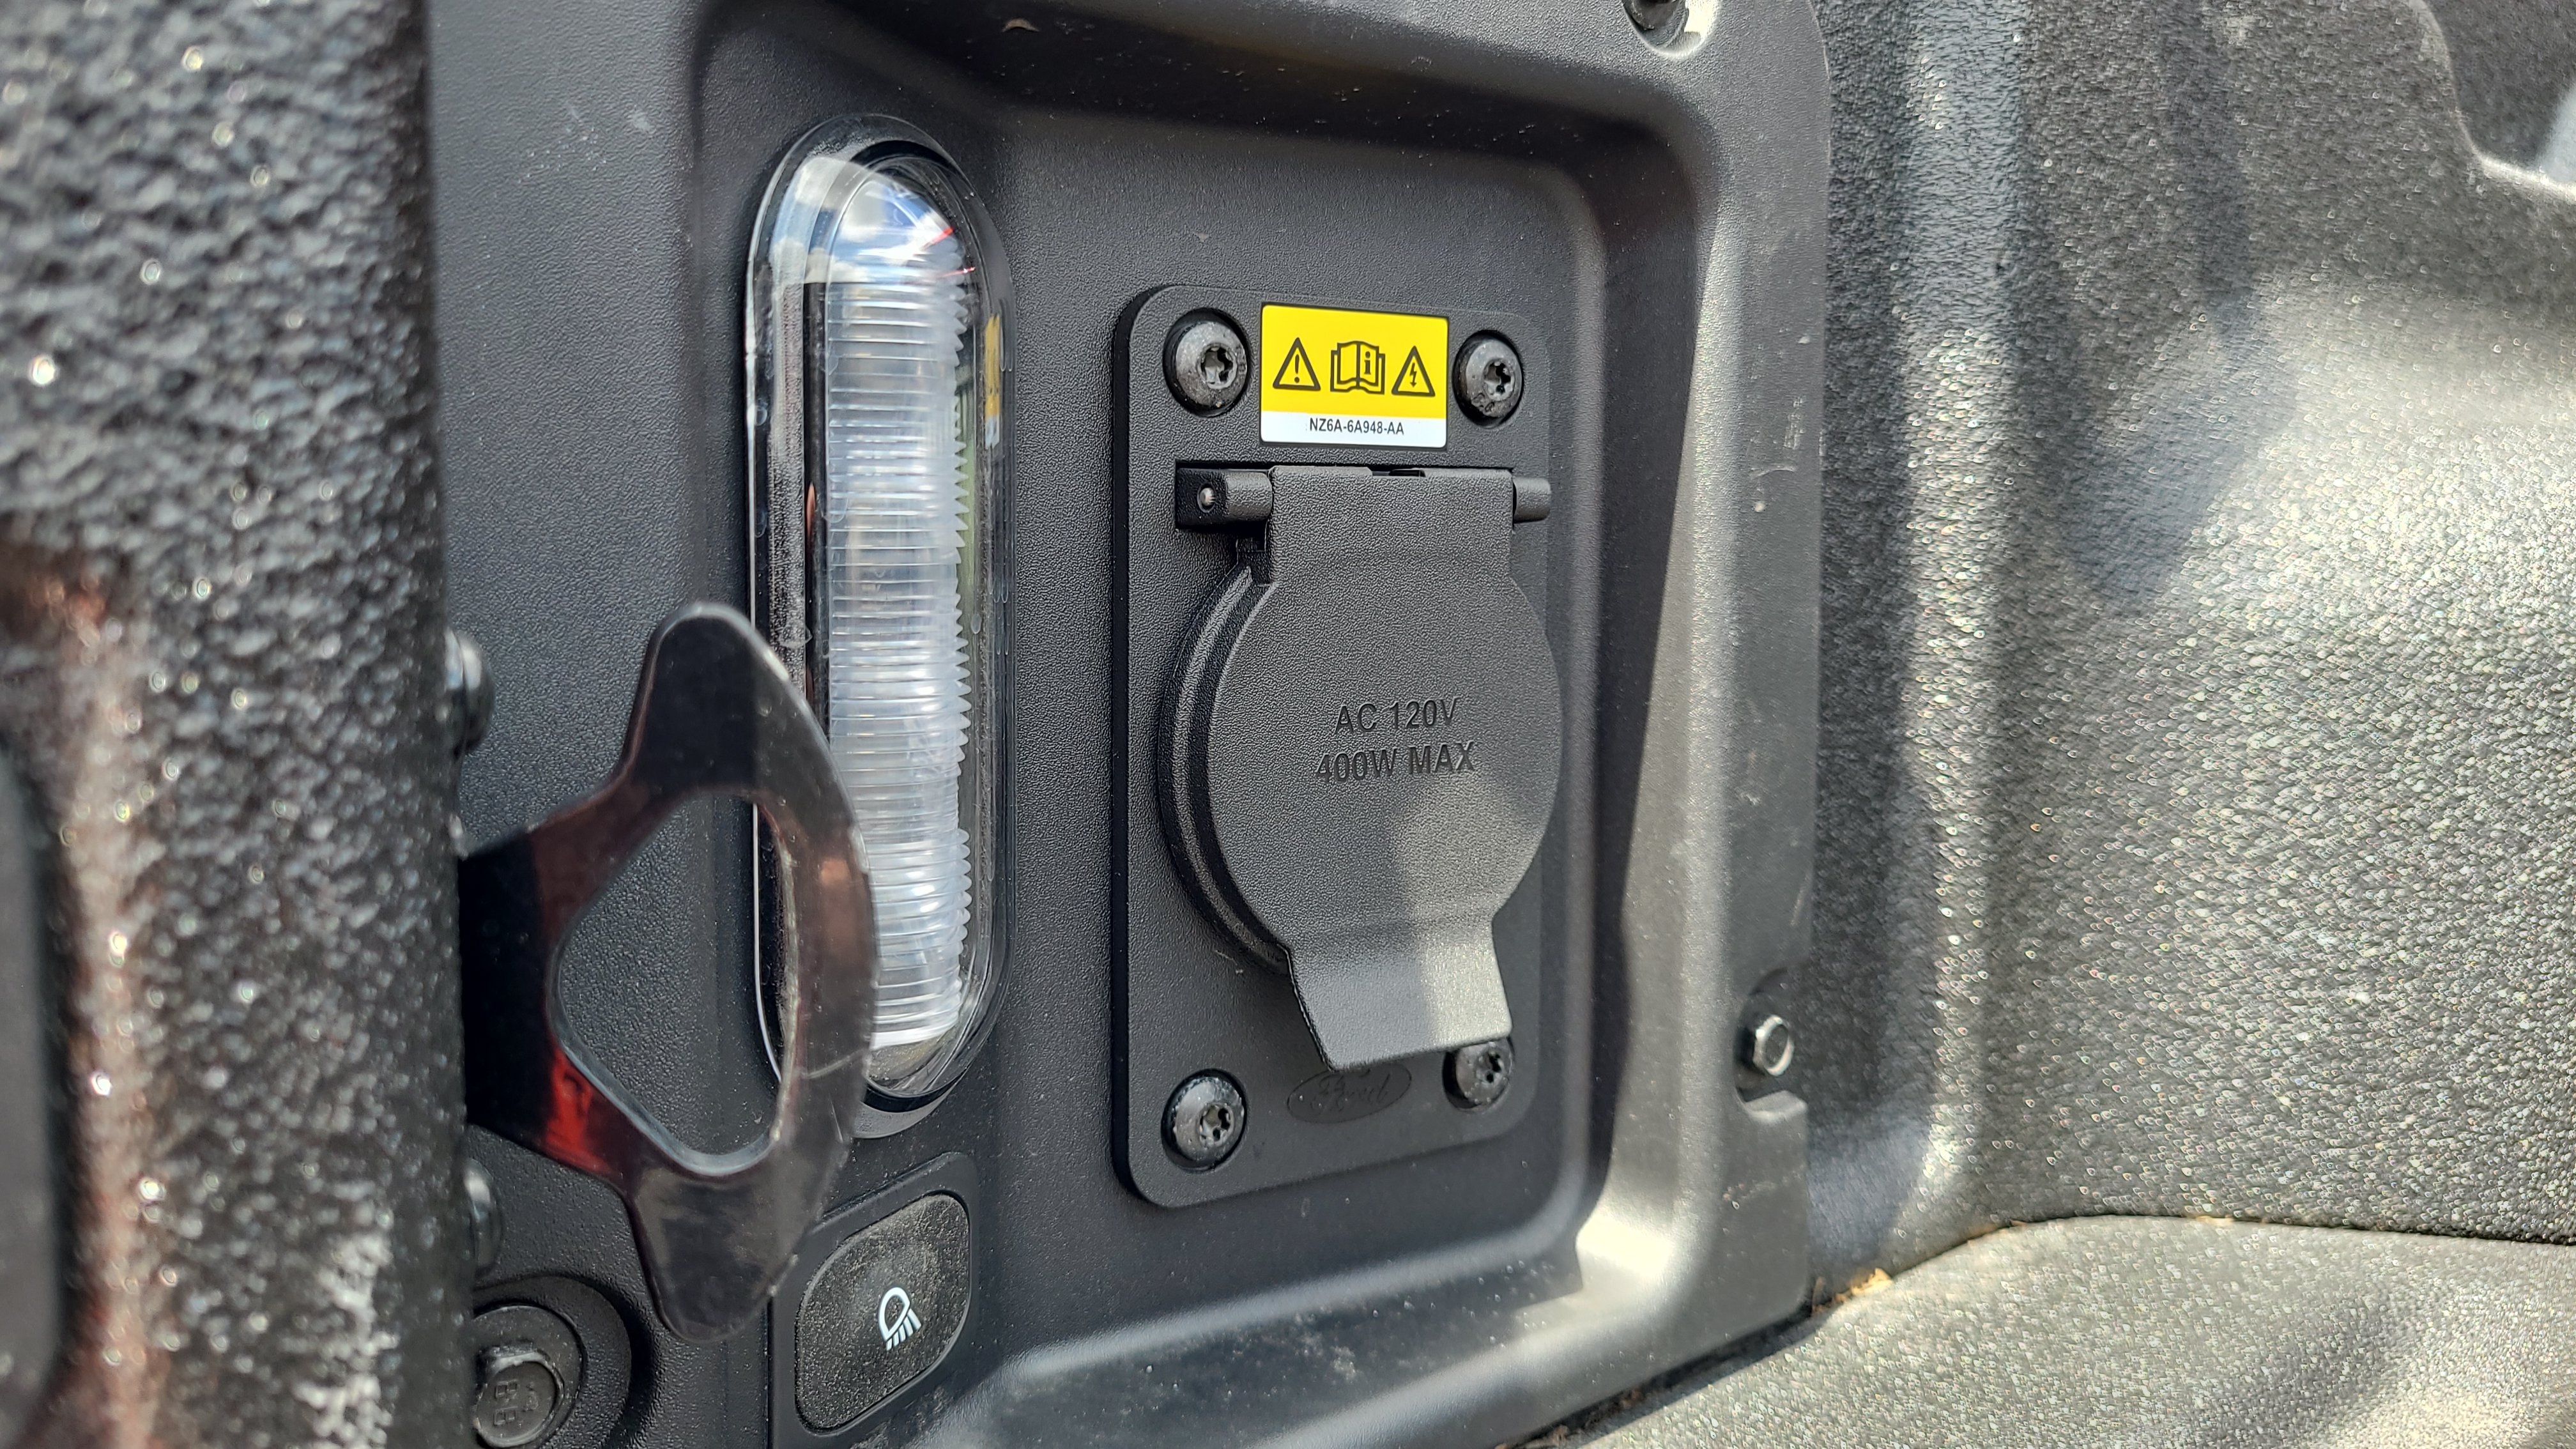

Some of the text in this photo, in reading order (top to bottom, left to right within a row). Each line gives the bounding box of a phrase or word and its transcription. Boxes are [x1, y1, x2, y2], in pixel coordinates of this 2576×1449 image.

[1309, 417, 1405, 436] NZ6A-6A948-AA
[1333, 696, 1460, 735] AC 120V
[1315, 740, 1475, 783] 400W MAX
